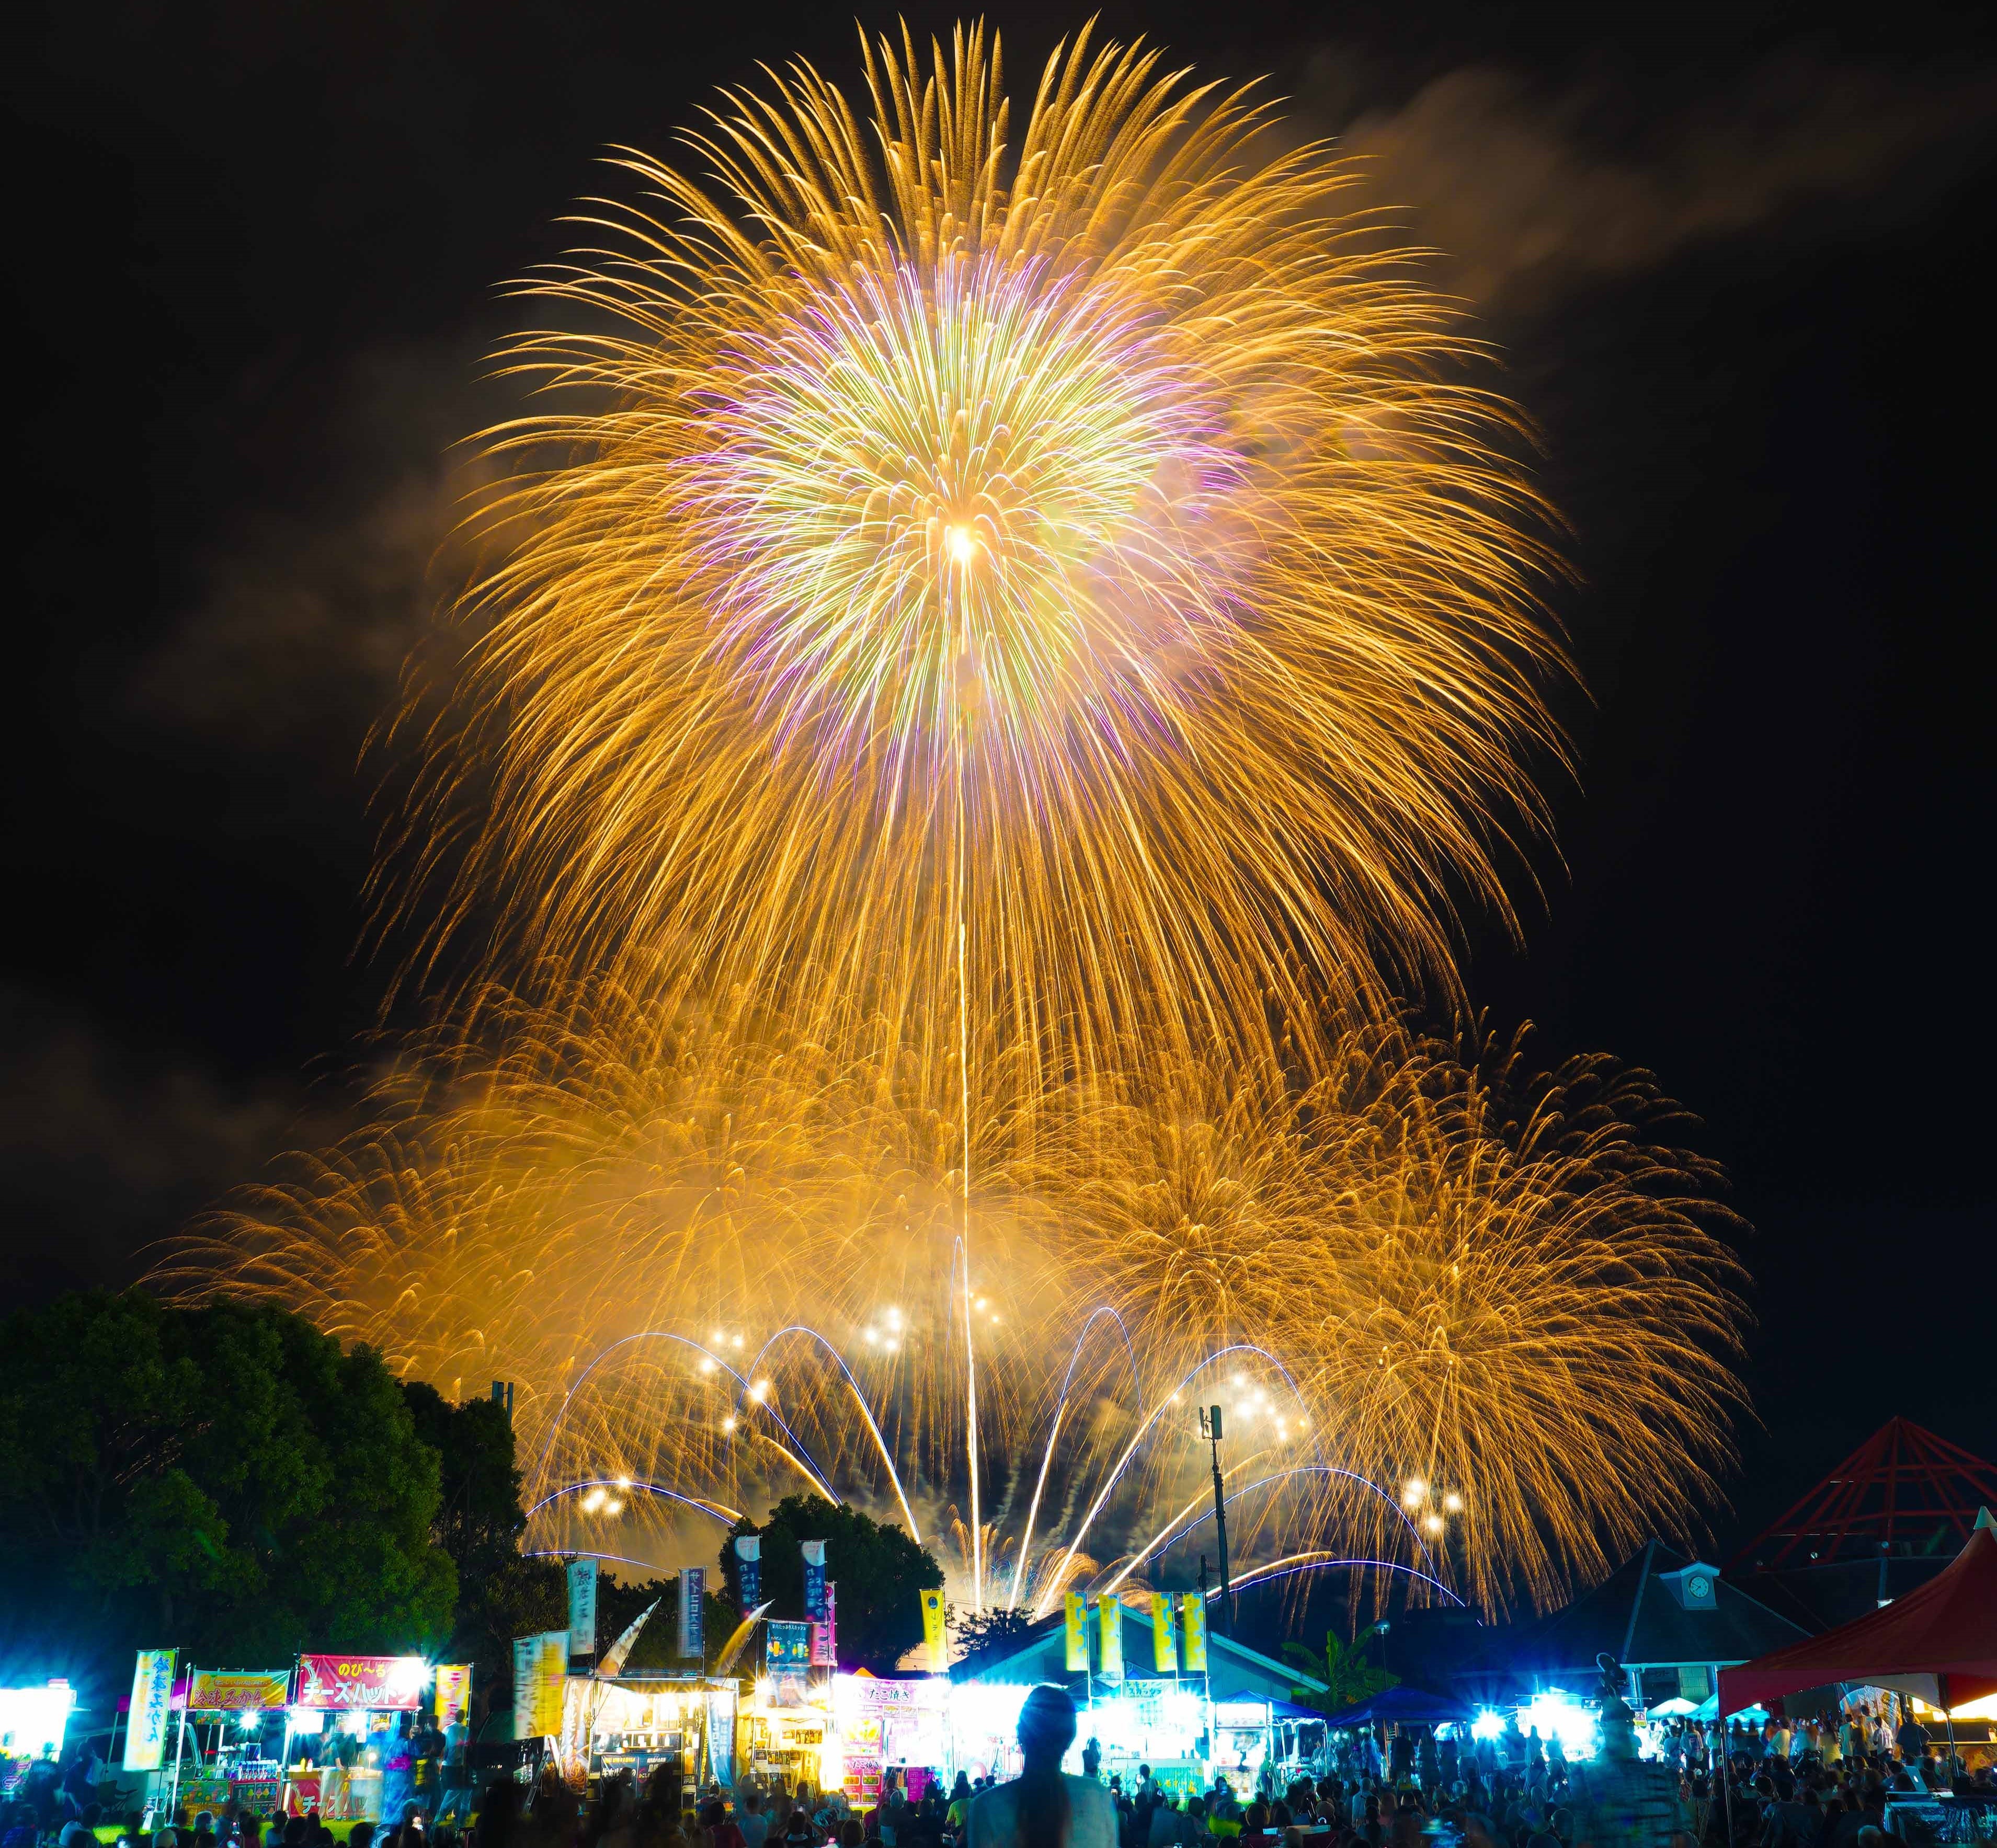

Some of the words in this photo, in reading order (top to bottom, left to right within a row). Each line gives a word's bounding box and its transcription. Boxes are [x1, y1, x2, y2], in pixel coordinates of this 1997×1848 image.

[193, 1688, 267, 1707] 冷凍みかん
[870, 1689, 910, 1701] たこ焼き
[853, 1760, 880, 1769] たこ焼き
